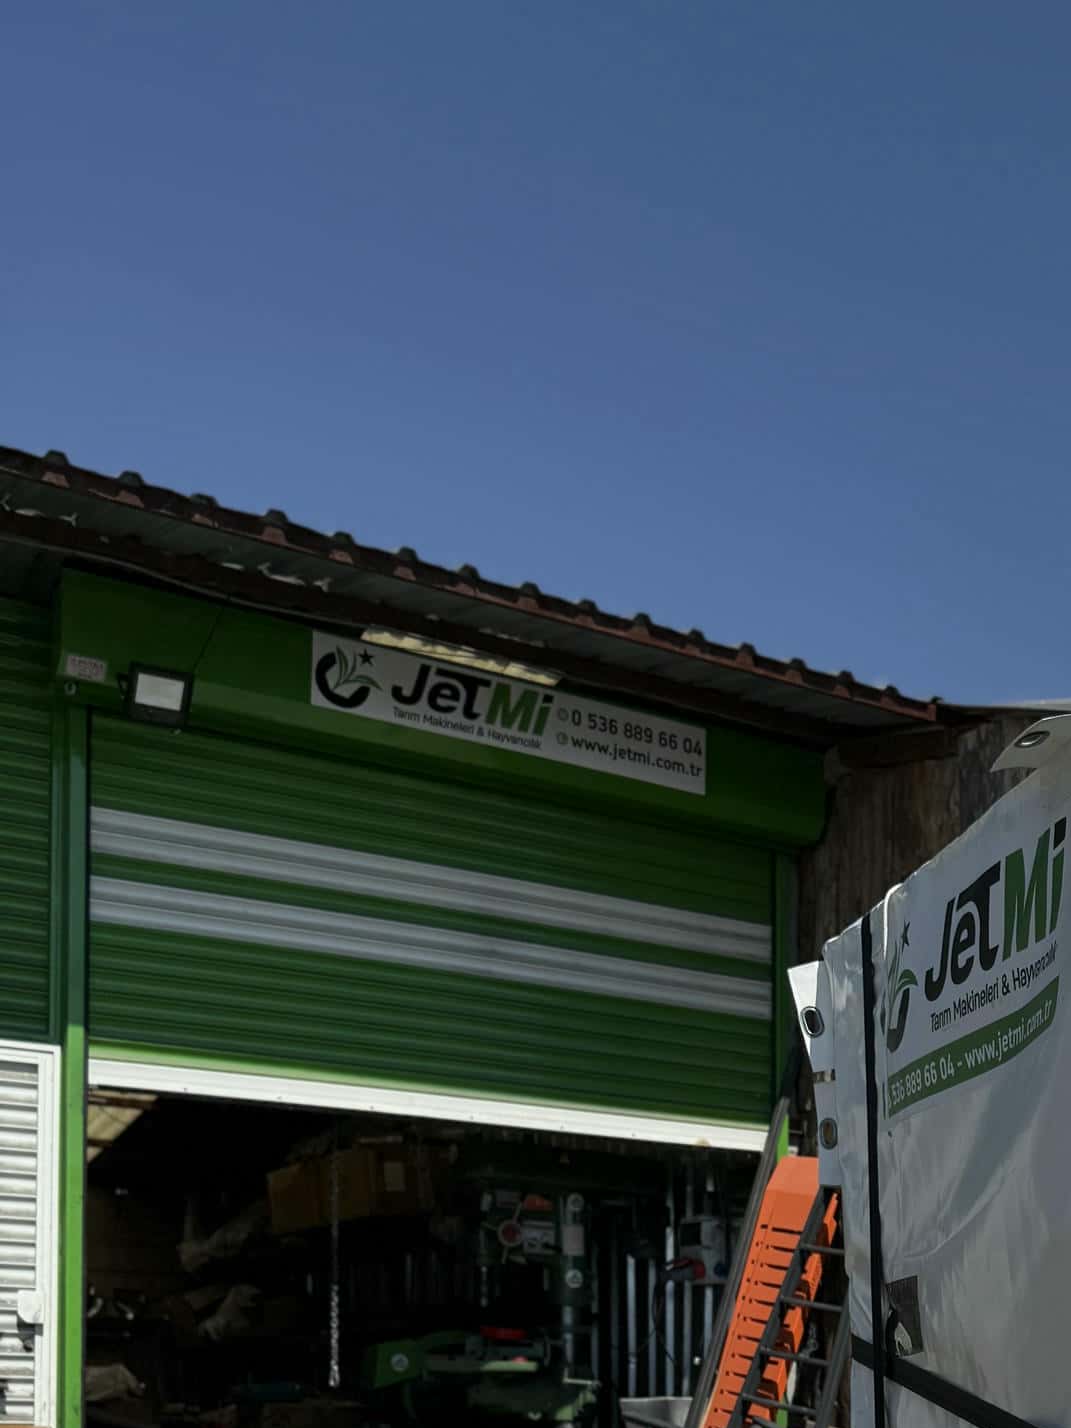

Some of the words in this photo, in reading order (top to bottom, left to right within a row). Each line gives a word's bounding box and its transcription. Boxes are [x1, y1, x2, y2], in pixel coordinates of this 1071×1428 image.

[571, 709, 582, 726] 0
[588, 713, 618, 735] 536
[623, 722, 653, 744] 889
[658, 731, 678, 750] 66
[683, 737, 703, 757] 04
[571, 736, 703, 777] www.jetmi.com.tr
[1001, 973, 1011, 996] &
[905, 1069, 922, 1096] 889
[924, 1061, 938, 1087] 66
[940, 1052, 955, 1080] 04
